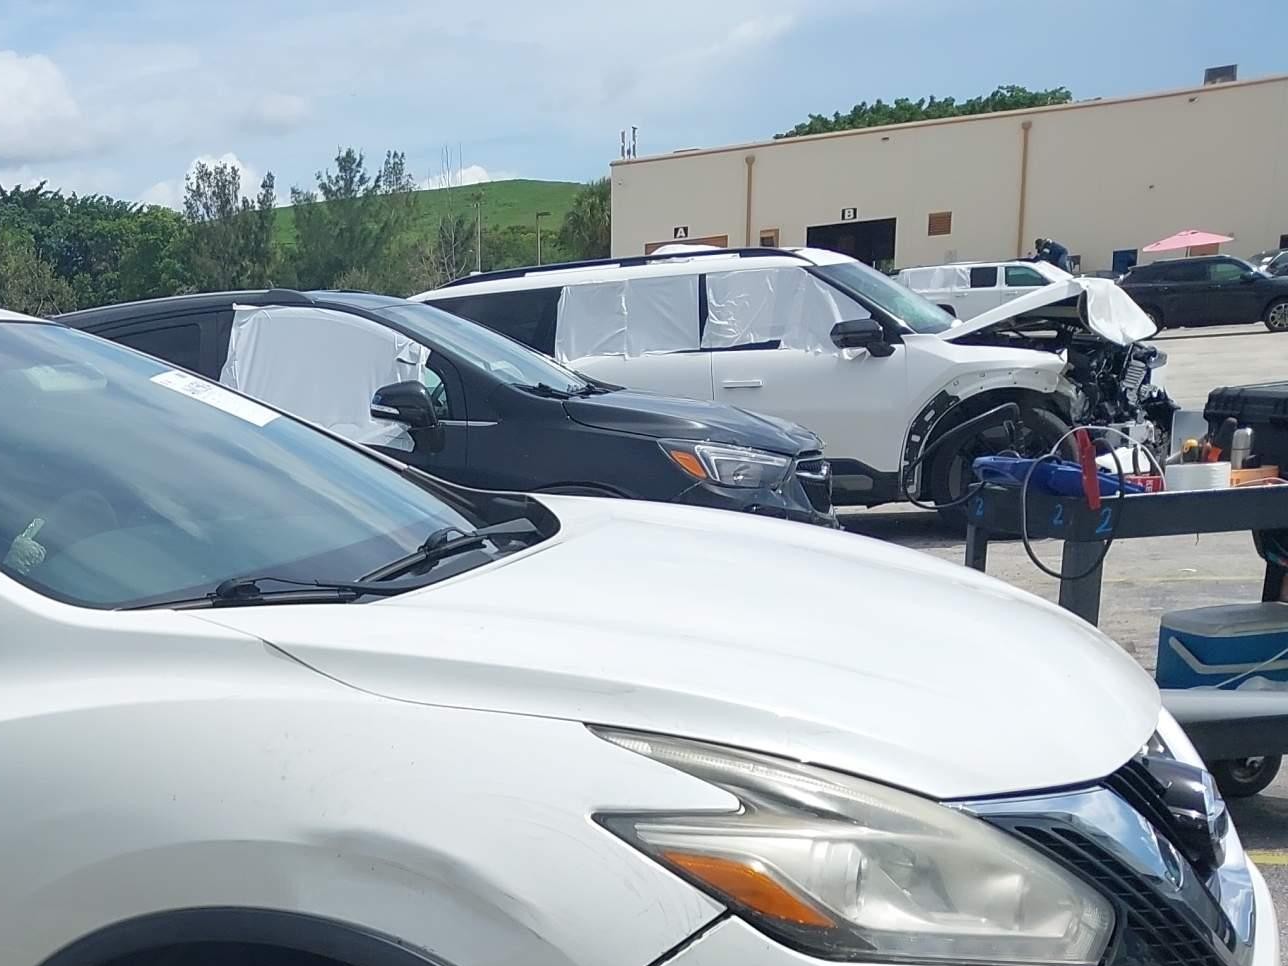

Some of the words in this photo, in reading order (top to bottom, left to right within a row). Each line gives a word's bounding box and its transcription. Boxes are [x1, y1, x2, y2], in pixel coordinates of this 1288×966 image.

[844, 209, 854, 220] B
[676, 228, 686, 238] A
[974, 497, 984, 516] 2
[1052, 503, 1064, 526] 2
[1096, 507, 1113, 534] 2
